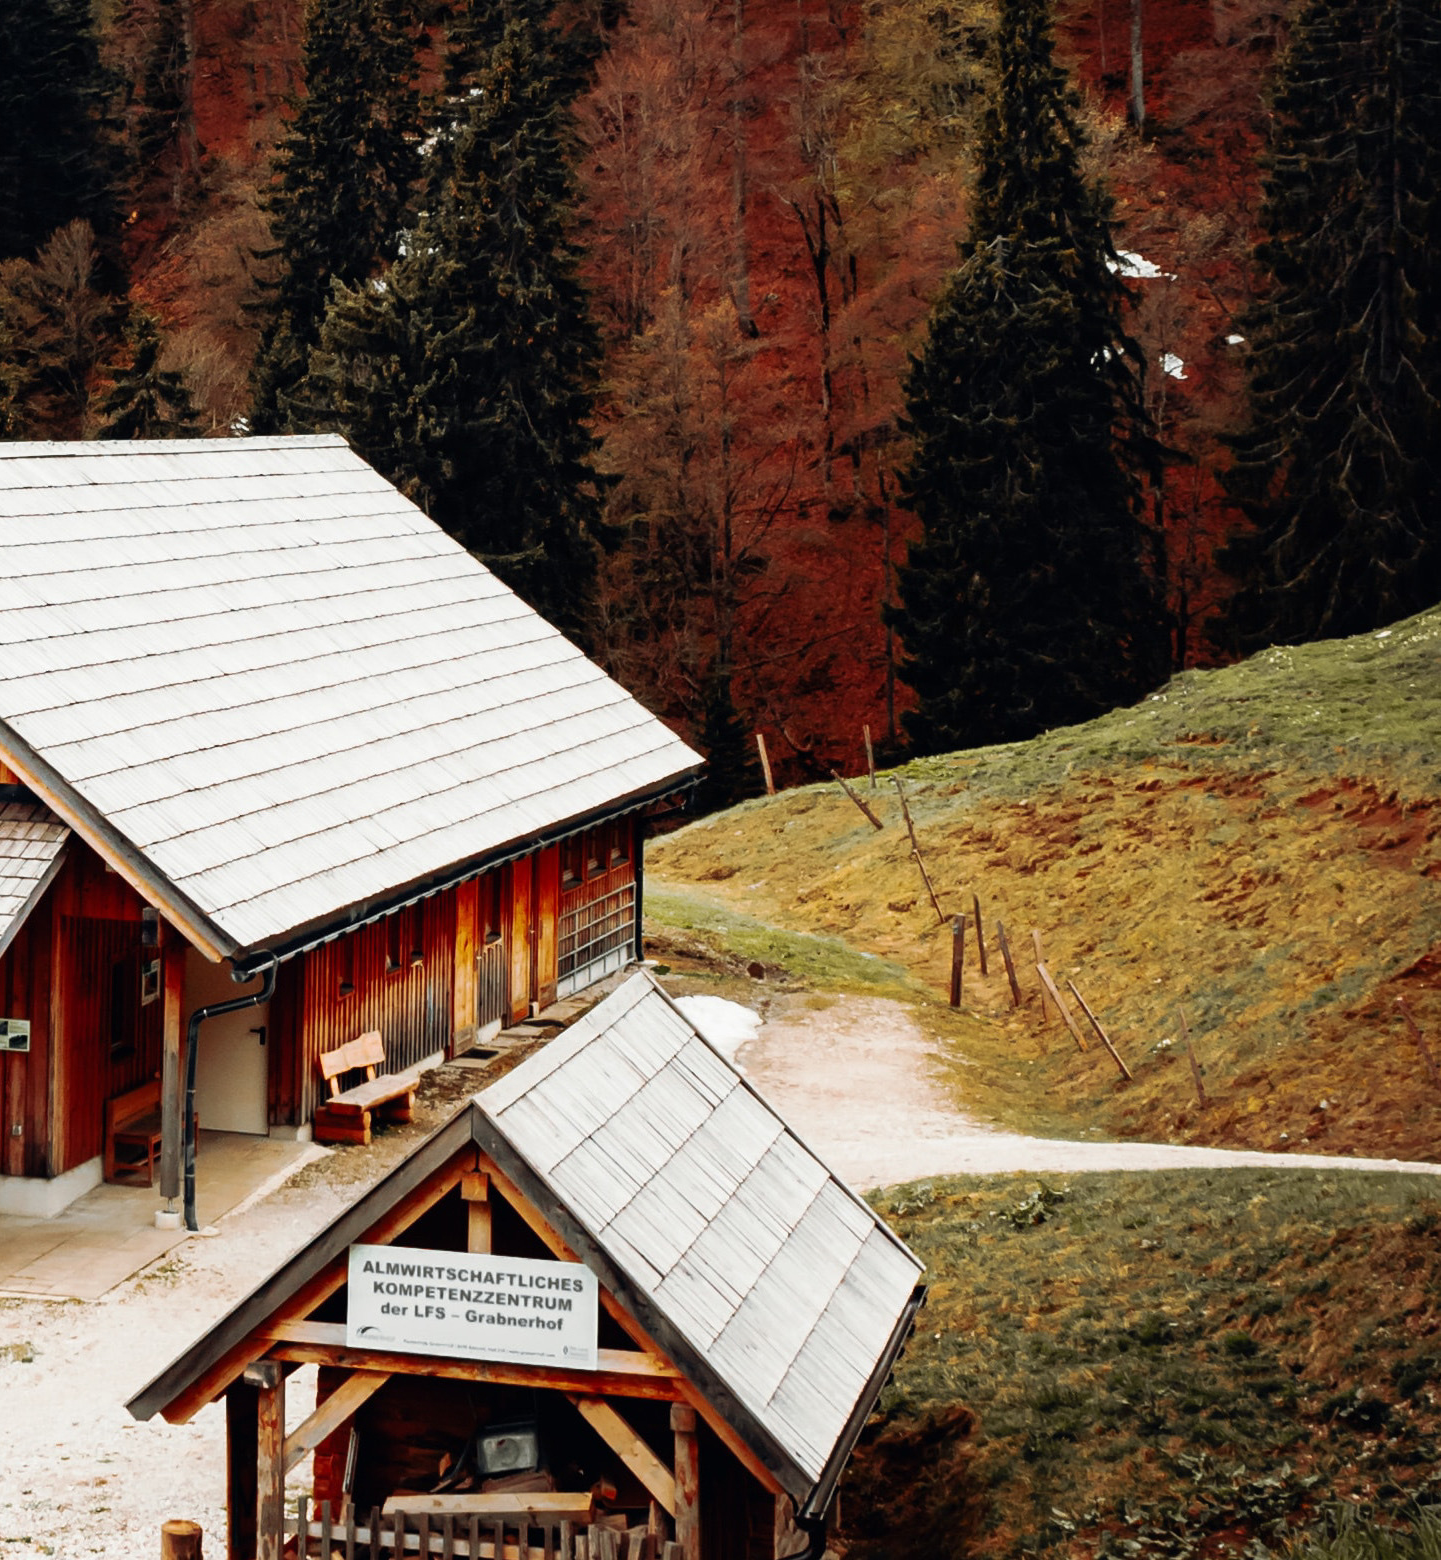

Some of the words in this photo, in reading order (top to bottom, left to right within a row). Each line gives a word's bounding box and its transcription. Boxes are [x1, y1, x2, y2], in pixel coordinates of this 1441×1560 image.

[362, 1260, 584, 1292] ALMWIRTSCHAFTLICHES
[373, 1281, 573, 1312] KOMPETENZZENTRUM
[381, 1302, 408, 1316] der
[414, 1305, 446, 1320] LFS
[465, 1309, 564, 1331] Grabnerhof
